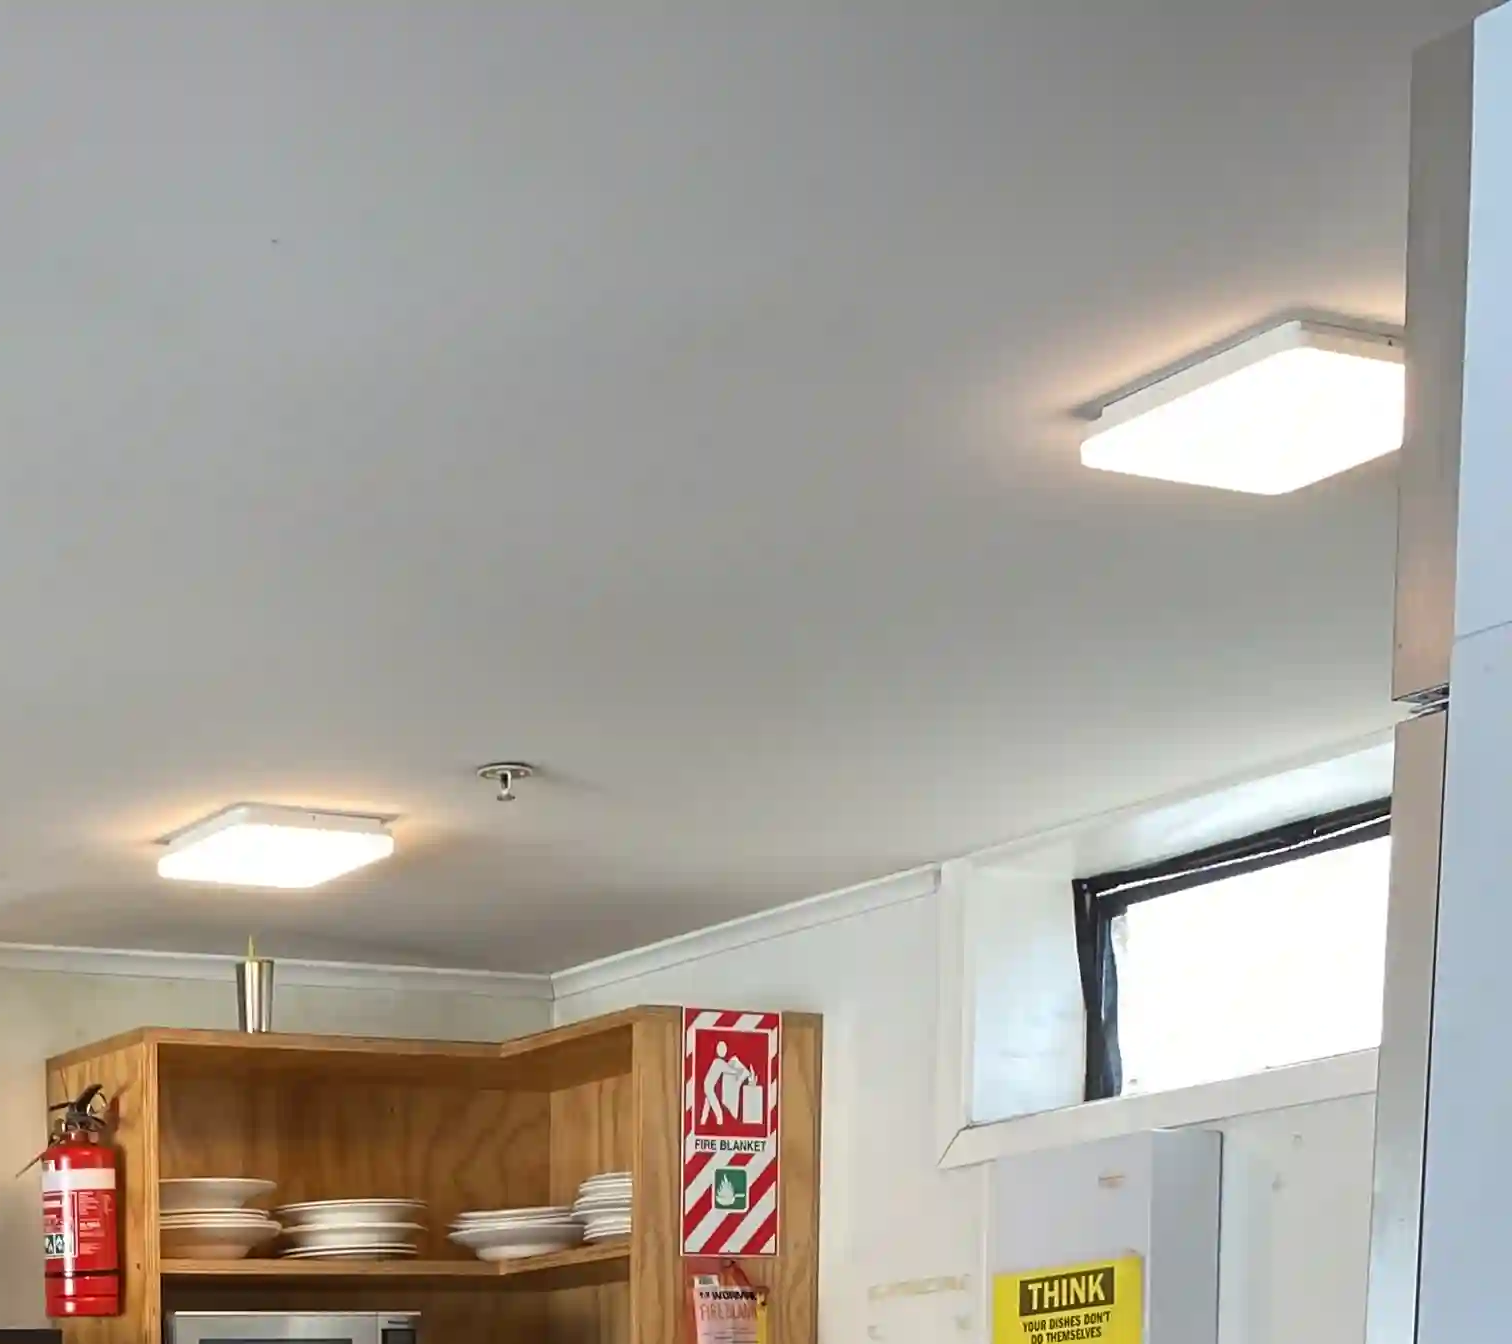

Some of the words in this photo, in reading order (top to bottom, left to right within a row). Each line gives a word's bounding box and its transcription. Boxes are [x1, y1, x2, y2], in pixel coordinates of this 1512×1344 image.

[695, 1139, 717, 1151] FIRE
[720, 1140, 767, 1152] BLANKET
[1028, 1272, 1105, 1310] THINK
[1023, 1319, 1046, 1333] YOUR
[1049, 1315, 1081, 1330] DISHES
[1084, 1310, 1111, 1326] DON'T
[1031, 1333, 1044, 1344] DO
[1046, 1326, 1102, 1343] THEMSELVES
